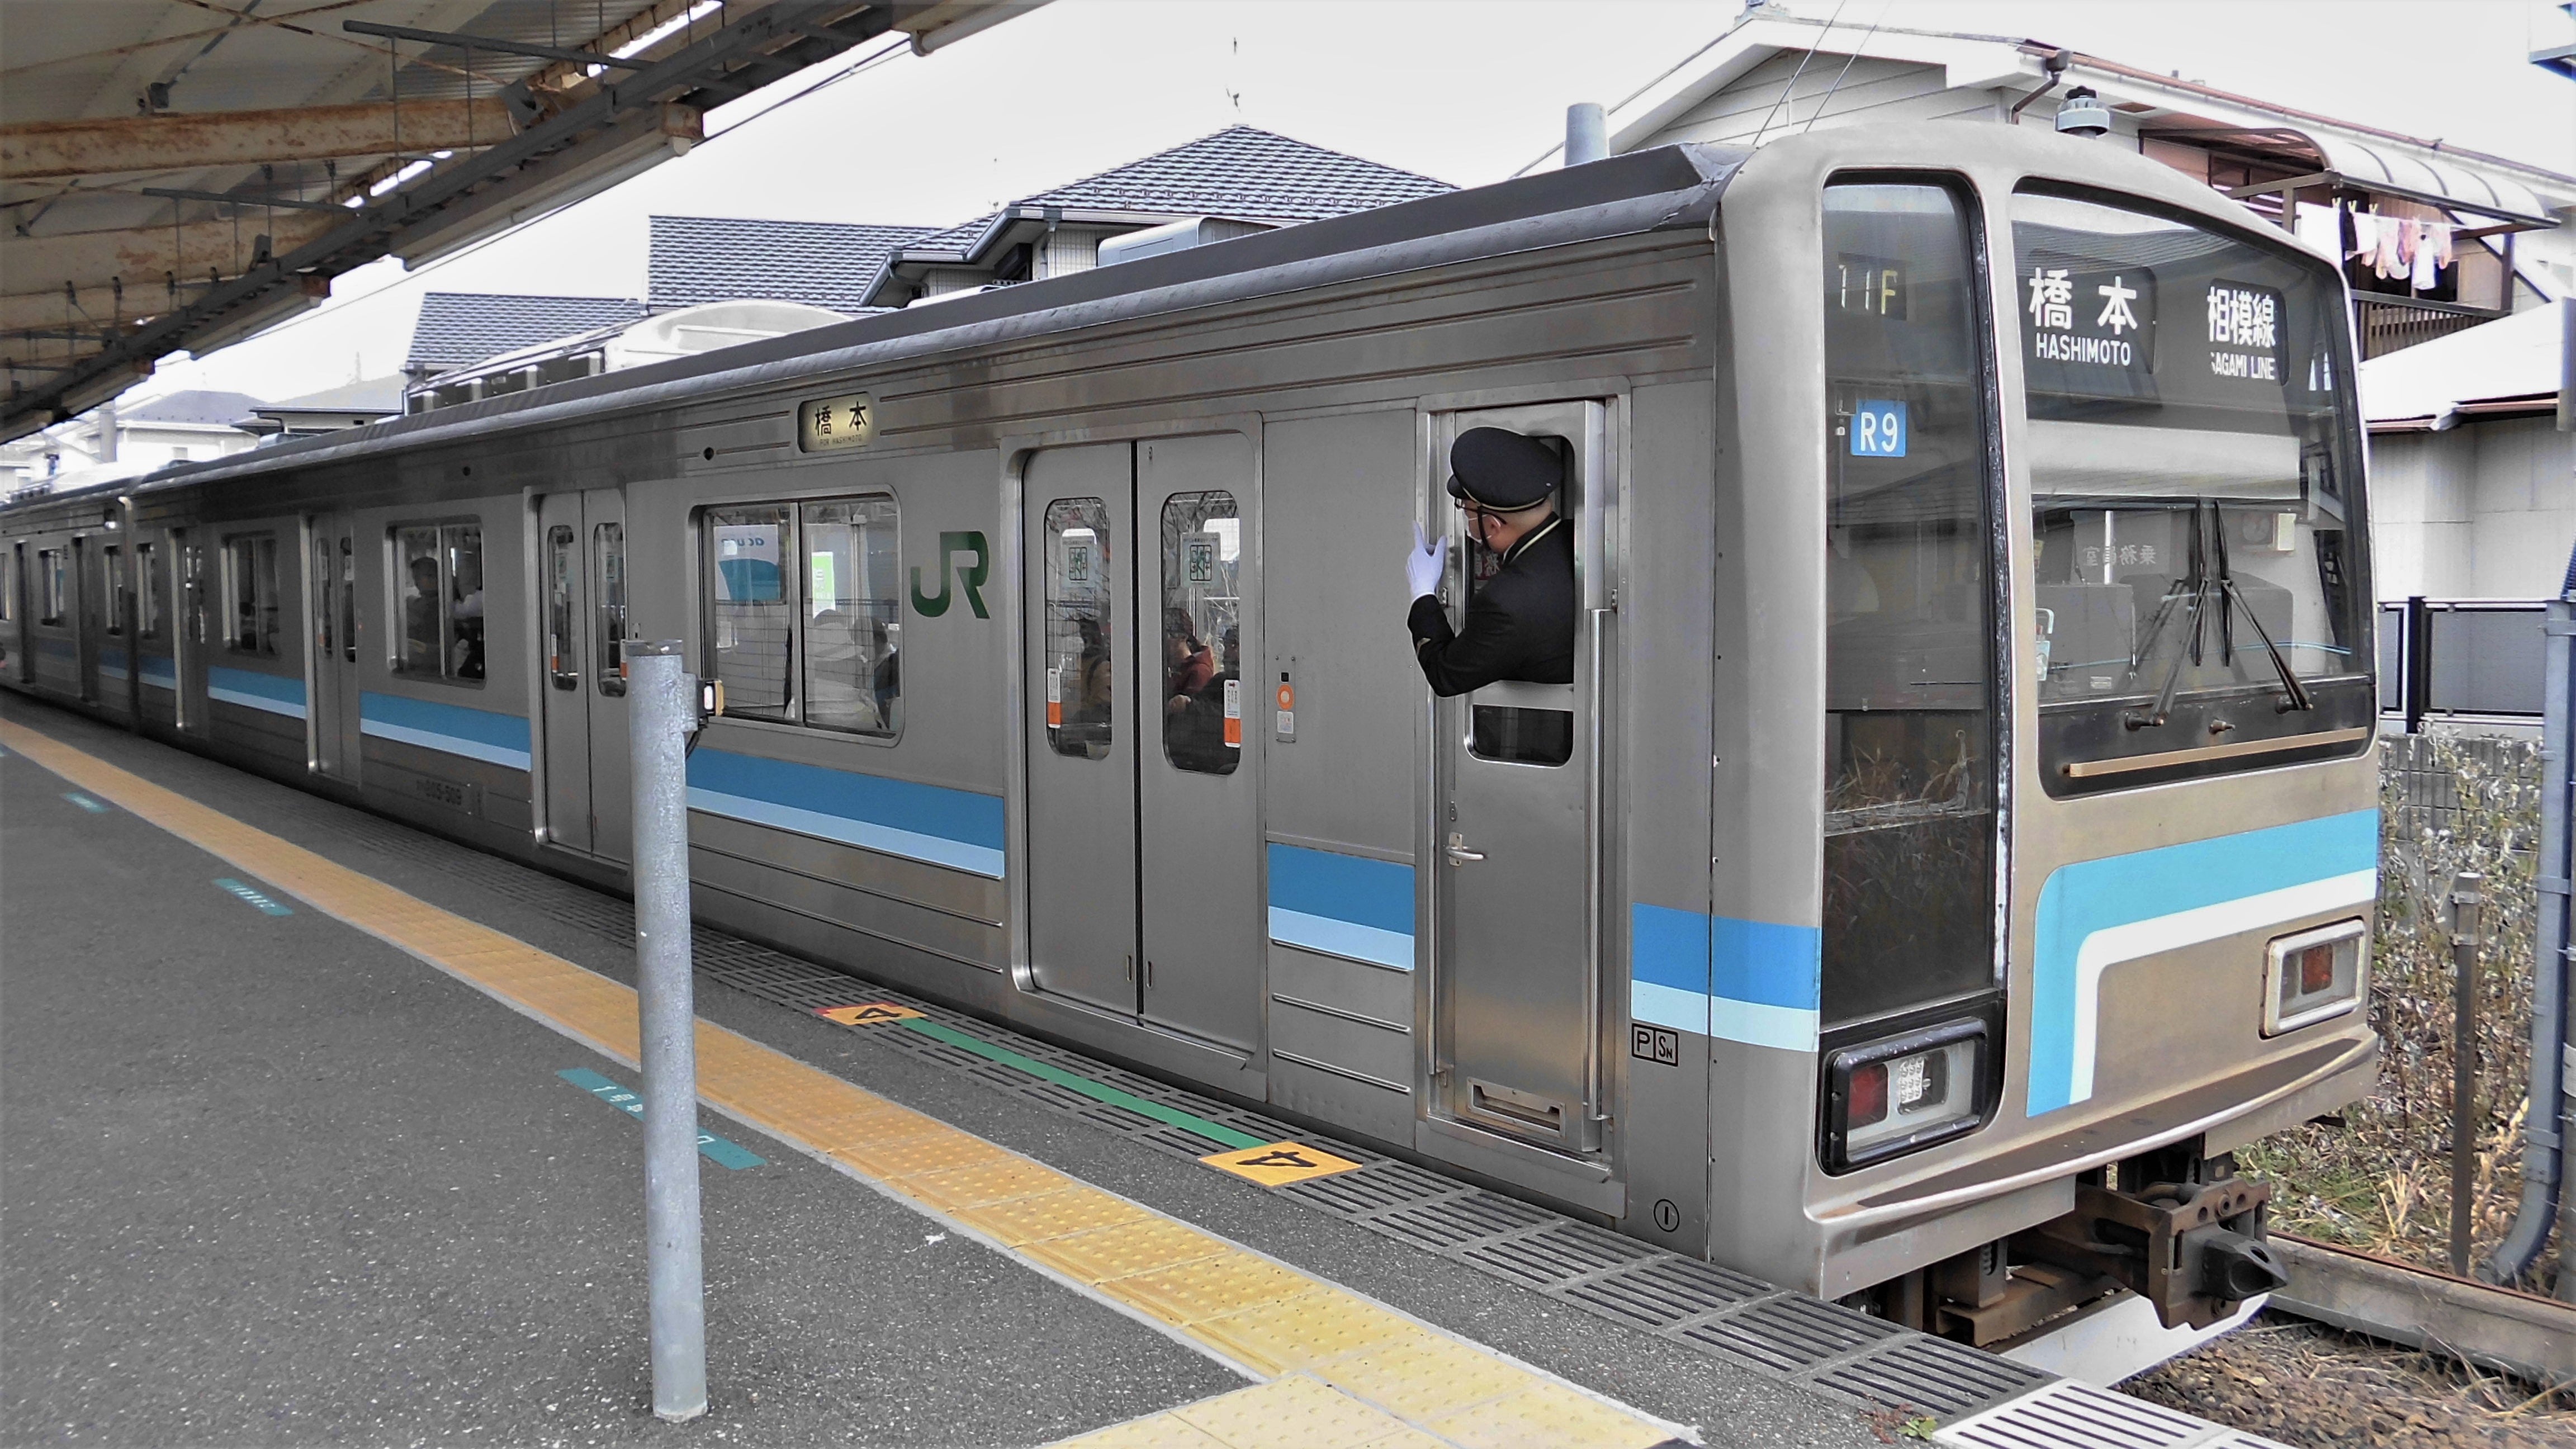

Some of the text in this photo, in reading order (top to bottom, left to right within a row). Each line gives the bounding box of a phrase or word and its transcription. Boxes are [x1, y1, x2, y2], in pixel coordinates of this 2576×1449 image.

[2029, 267, 2138, 335] 橋本
[2207, 286, 2276, 348] 相模線
[2037, 332, 2130, 366] HASHIMOTO
[2251, 356, 2275, 380] LINE
[815, 401, 867, 436] 橋本
[1860, 411, 1898, 452] R9
[910, 531, 990, 619] JR
[1236, 1150, 1317, 1167] 4
